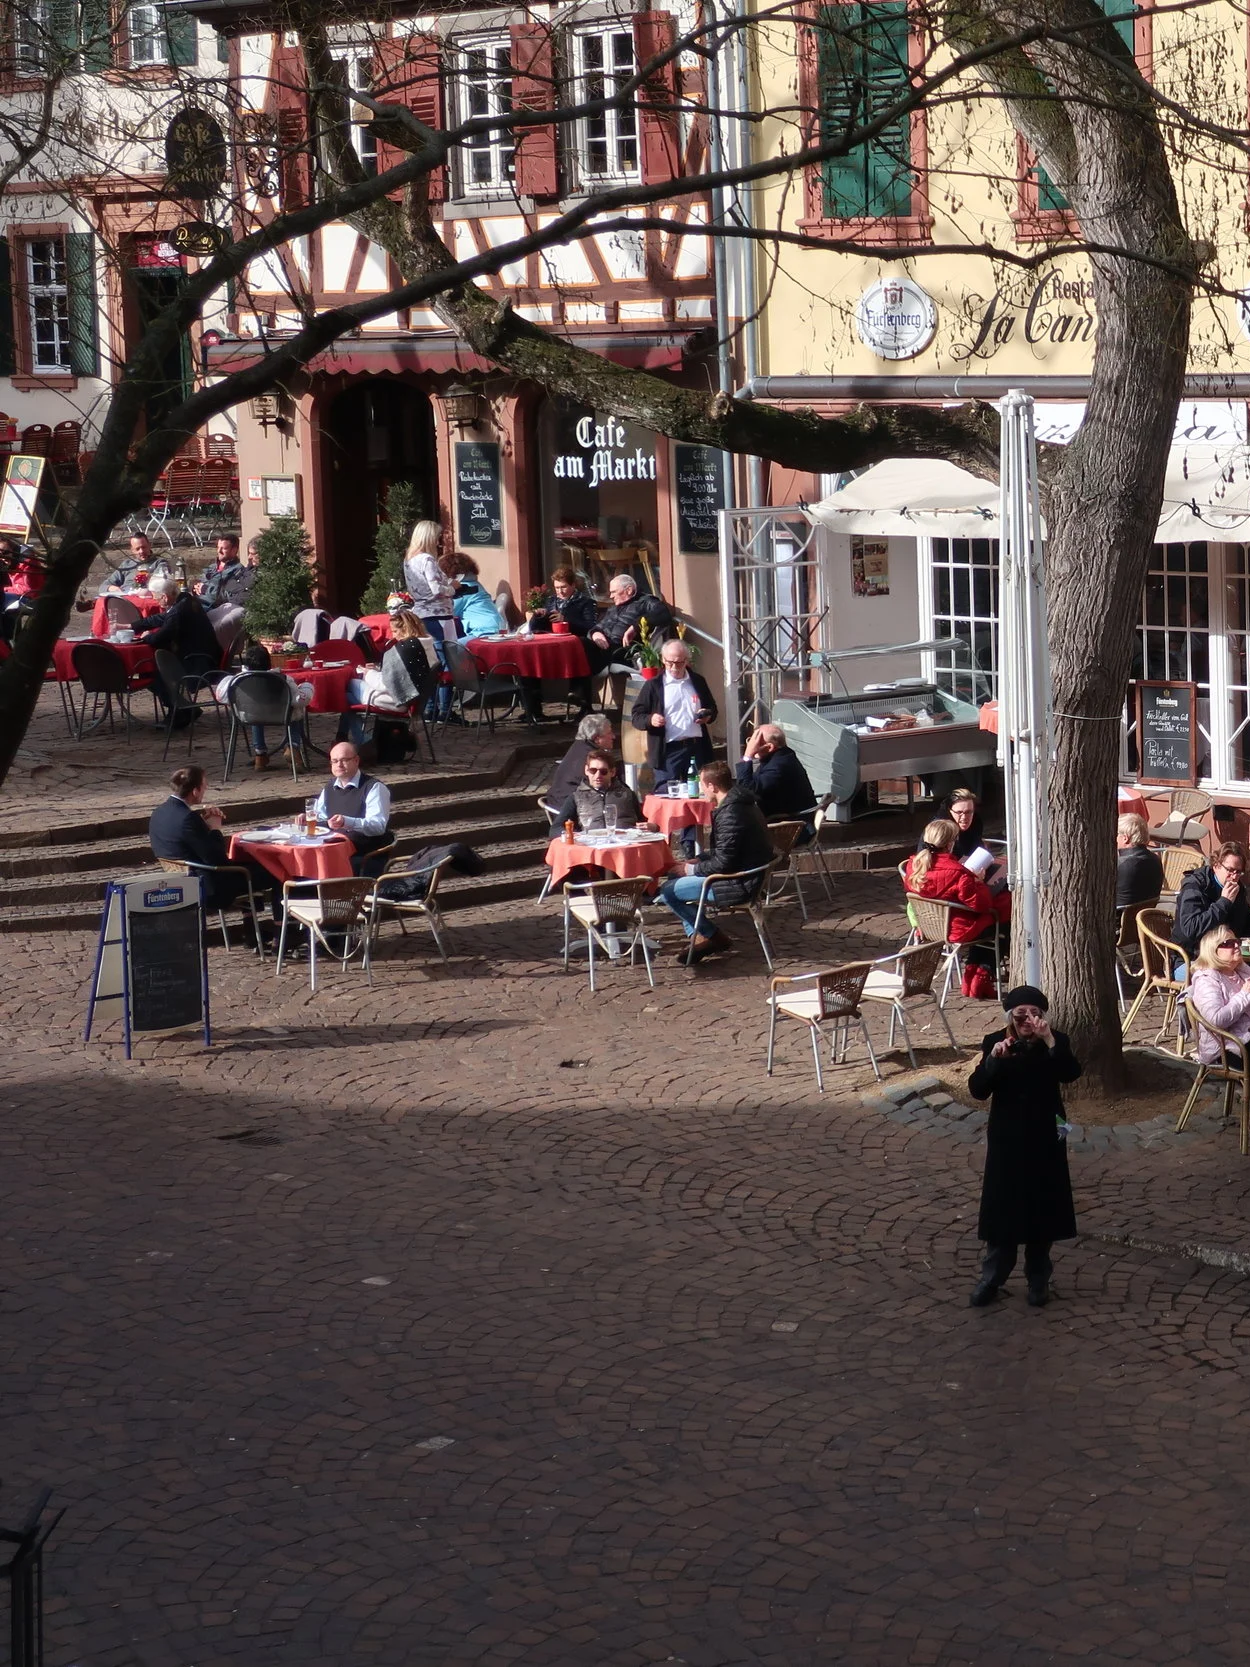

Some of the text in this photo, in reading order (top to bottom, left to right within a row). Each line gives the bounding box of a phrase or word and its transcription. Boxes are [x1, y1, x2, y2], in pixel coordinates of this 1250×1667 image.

[1053, 277, 1095, 300] Resta
[949, 284, 1016, 360] La
[576, 416, 627, 449] Café
[553, 448, 657, 489] am Markt
[704, 473, 715, 481] ab
[147, 892, 180, 903] Fürstenberg
